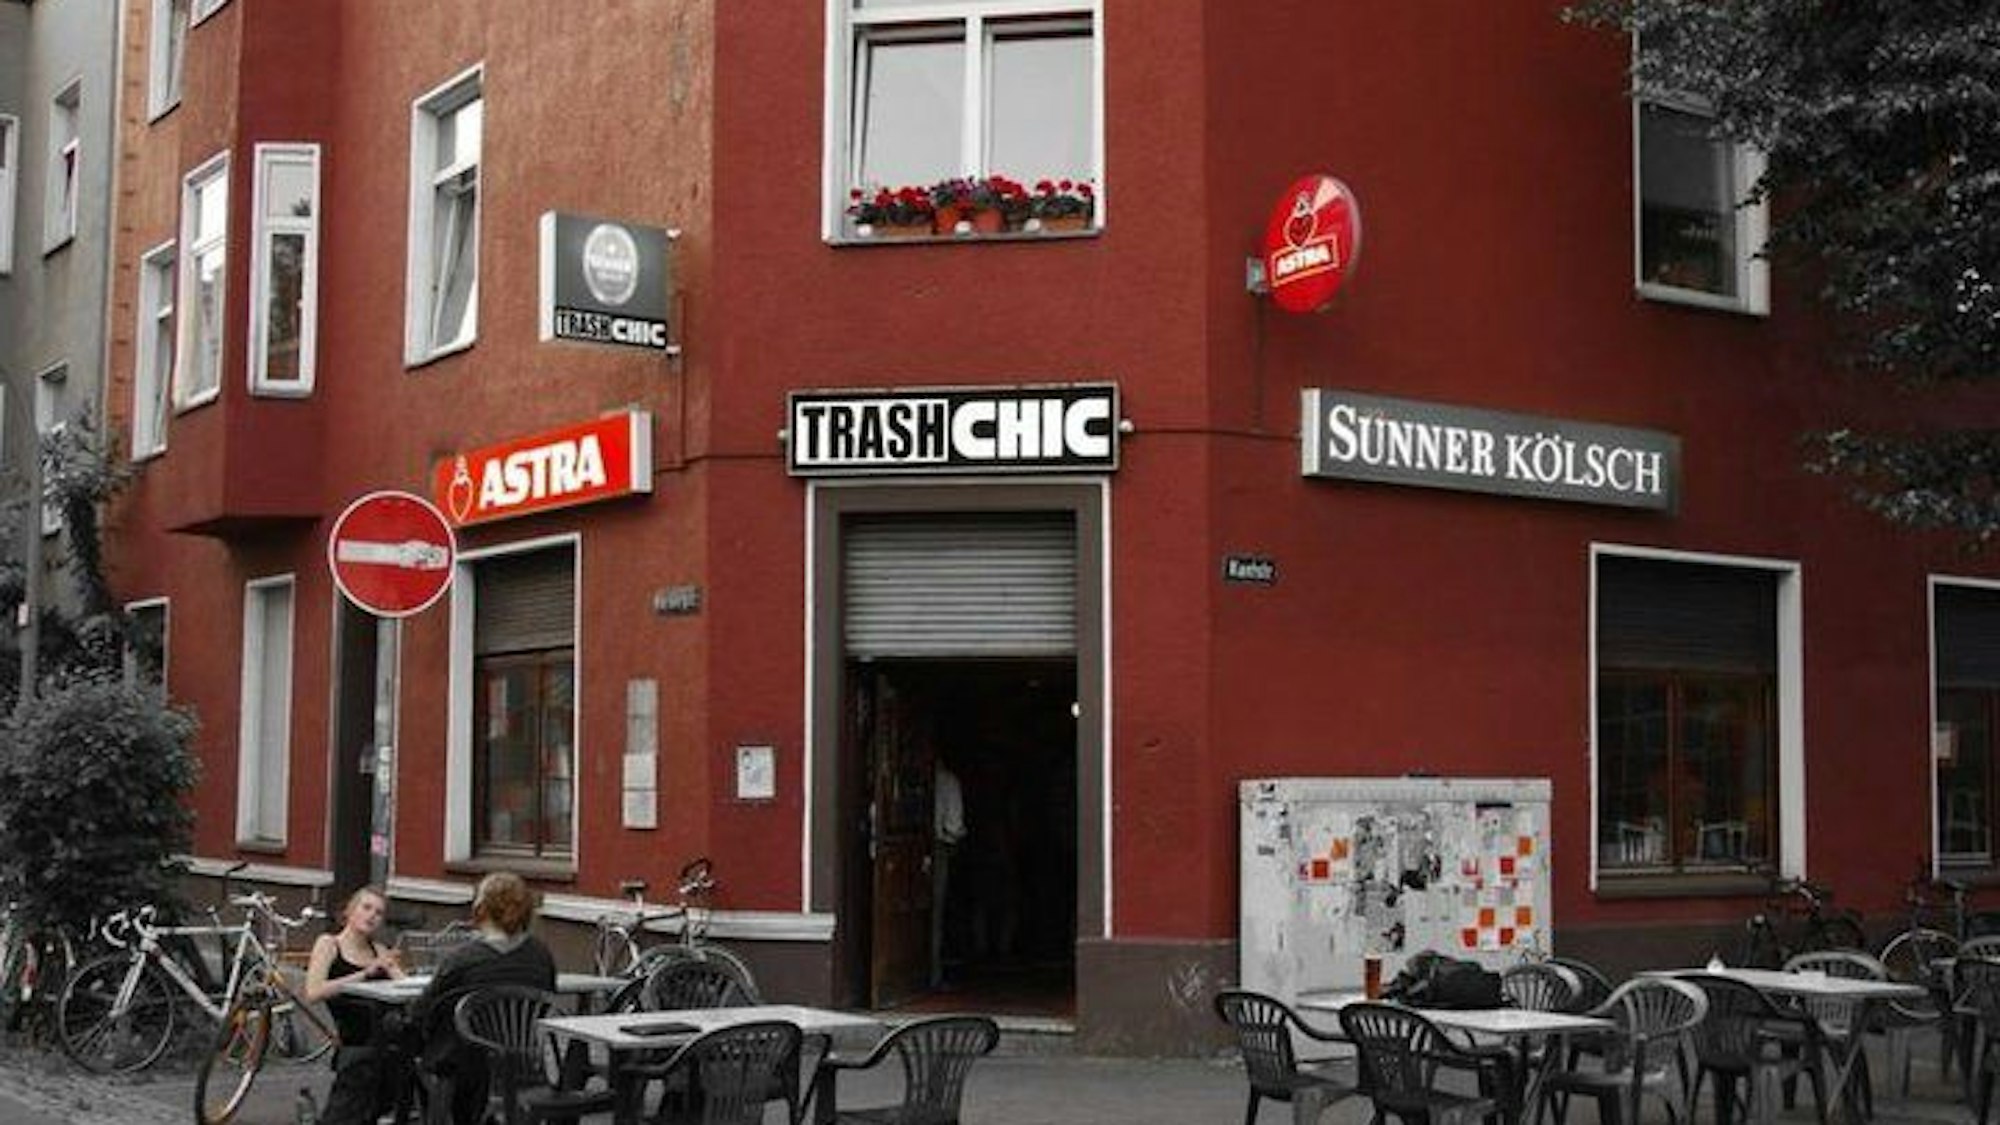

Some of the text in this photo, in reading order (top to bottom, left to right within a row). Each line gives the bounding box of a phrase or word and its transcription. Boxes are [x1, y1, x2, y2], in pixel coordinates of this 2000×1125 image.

[1276, 243, 1331, 277] ASTRA
[802, 398, 1109, 459] TRASH CHIC
[479, 434, 606, 509] ASTRA
[1504, 432, 1663, 495] KÖLSCH
